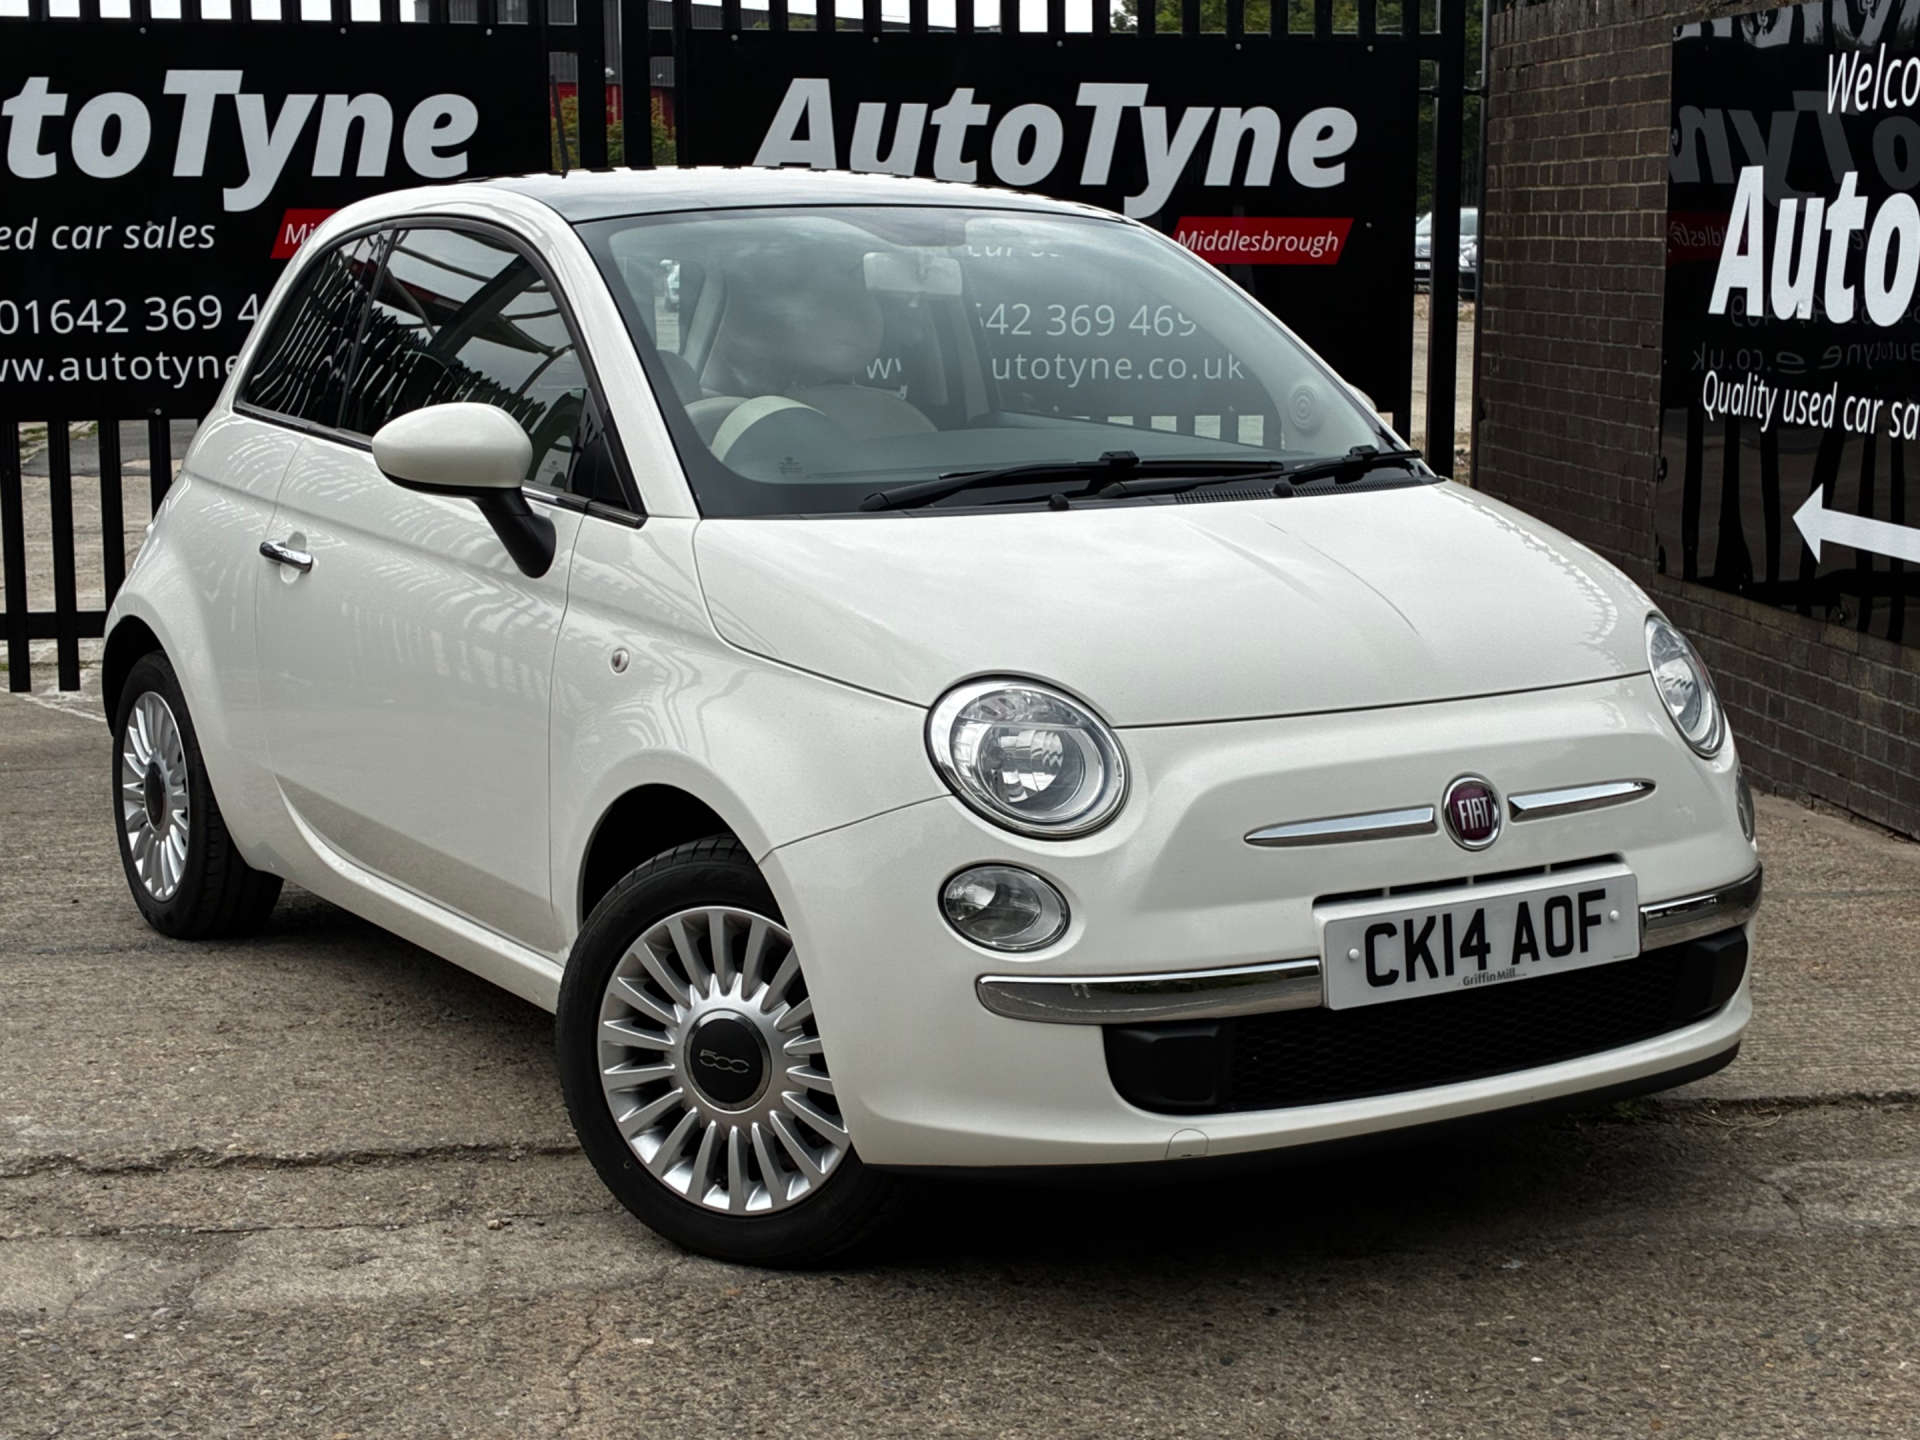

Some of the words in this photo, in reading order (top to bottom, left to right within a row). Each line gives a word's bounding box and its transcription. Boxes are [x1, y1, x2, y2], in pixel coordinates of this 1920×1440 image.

[752, 77, 1358, 218] AutoTyne
[51, 223, 112, 250] car
[123, 216, 216, 250] sales
[1178, 229, 1339, 258] Middlesbrough
[1707, 165, 1920, 327] Auto
[0, 298, 129, 334] 01642
[144, 294, 222, 332] 369
[1046, 303, 1115, 336] 369
[1702, 369, 1778, 433] Quality
[1783, 380, 1838, 430] used
[1843, 394, 1883, 434] car
[1457, 796, 1490, 831] FIAT
[1364, 907, 1491, 988] CK14
[1511, 887, 1606, 966] AOF
[699, 1048, 751, 1074] 500
